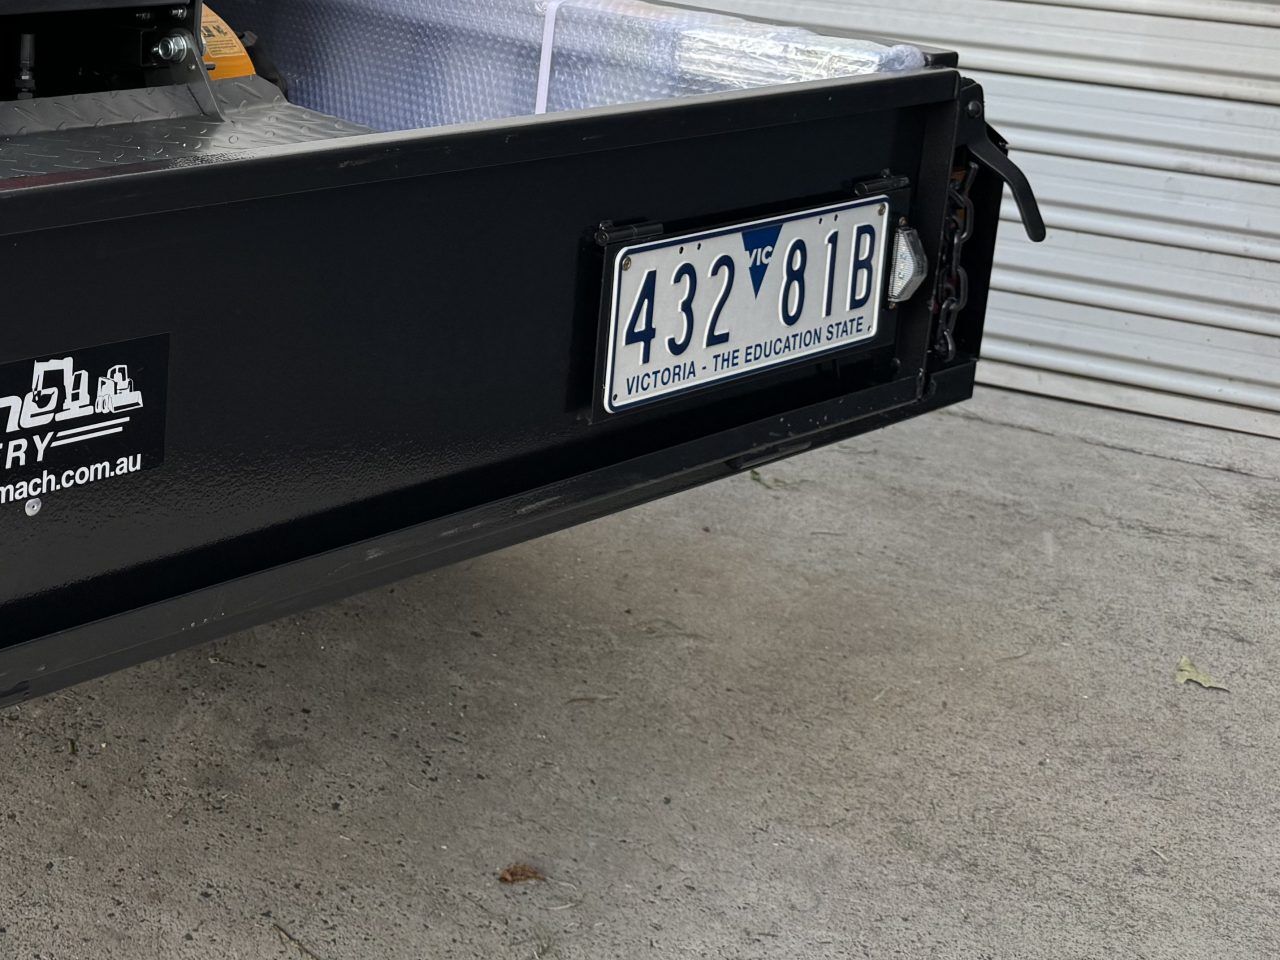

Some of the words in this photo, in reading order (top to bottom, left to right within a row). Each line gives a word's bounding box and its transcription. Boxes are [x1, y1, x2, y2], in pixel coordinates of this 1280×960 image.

[622, 254, 735, 366] 432
[778, 224, 877, 327] 81B
[746, 245, 773, 268] VIC
[626, 360, 696, 396] VICTORIA
[713, 348, 740, 372] THE
[745, 327, 821, 364] EDUCATION
[826, 316, 864, 341] STATE
